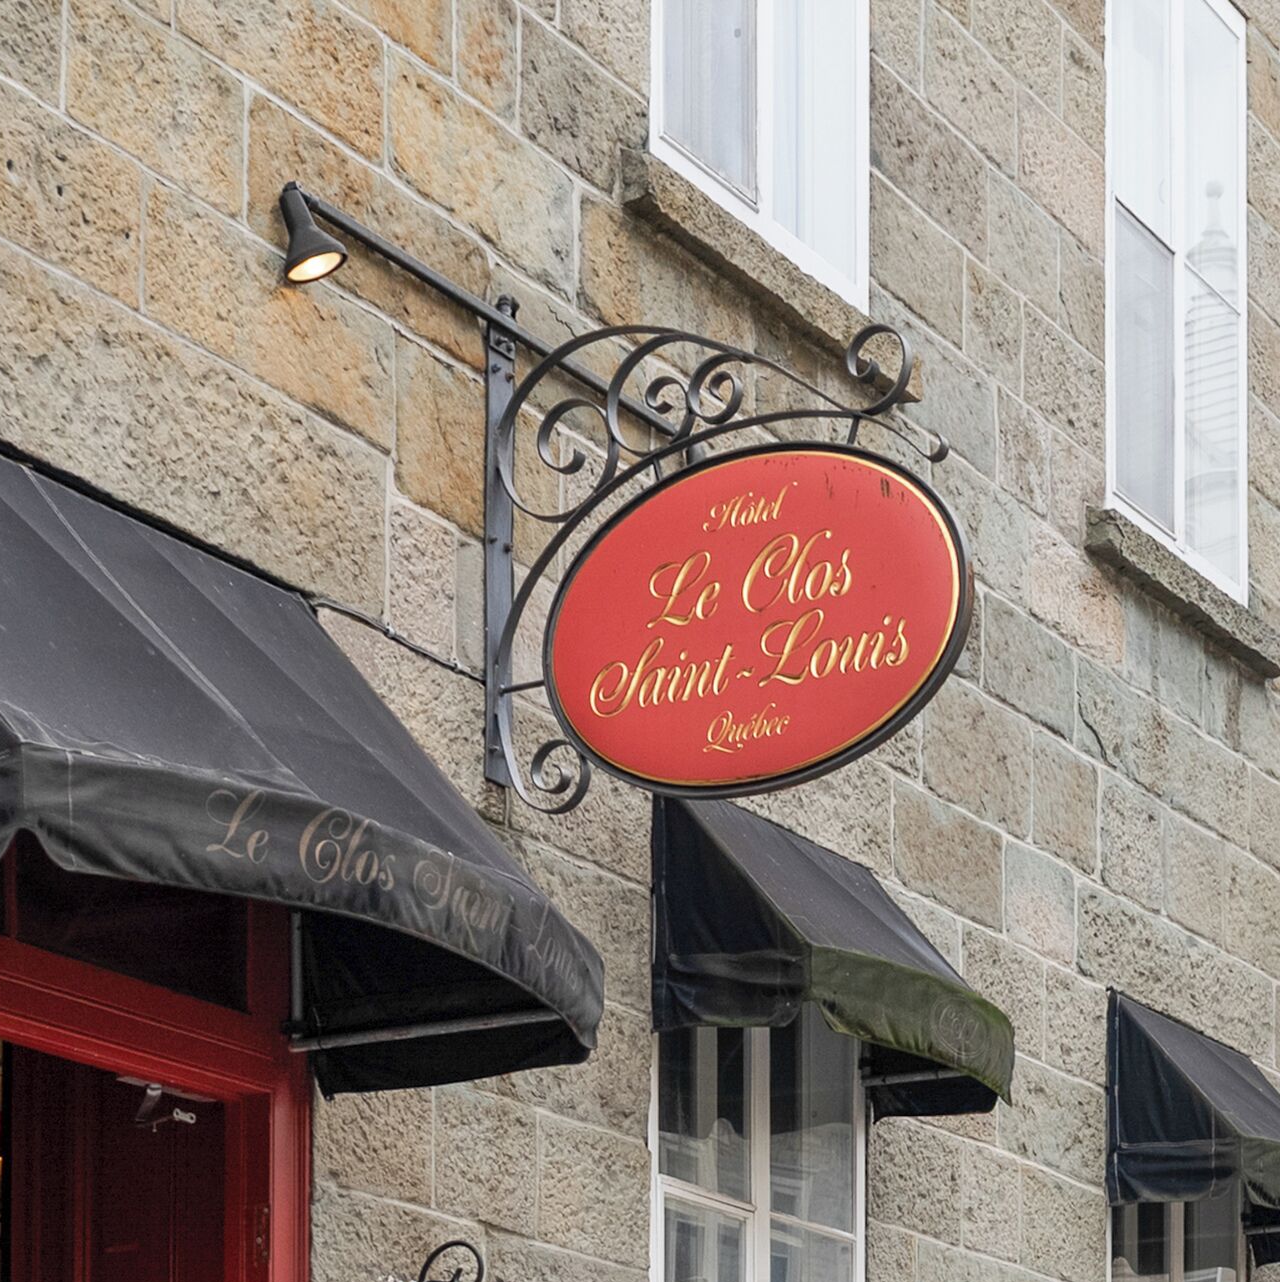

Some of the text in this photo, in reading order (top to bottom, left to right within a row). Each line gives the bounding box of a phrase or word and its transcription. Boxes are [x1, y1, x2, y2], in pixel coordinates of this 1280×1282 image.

[703, 482, 798, 533] Hôtel
[647, 529, 852, 629] Le Clos
[589, 608, 910, 717] Saint-Louis
[702, 702, 791, 753] Québec
[205, 789, 270, 865] Le
[298, 807, 396, 891] Clos
